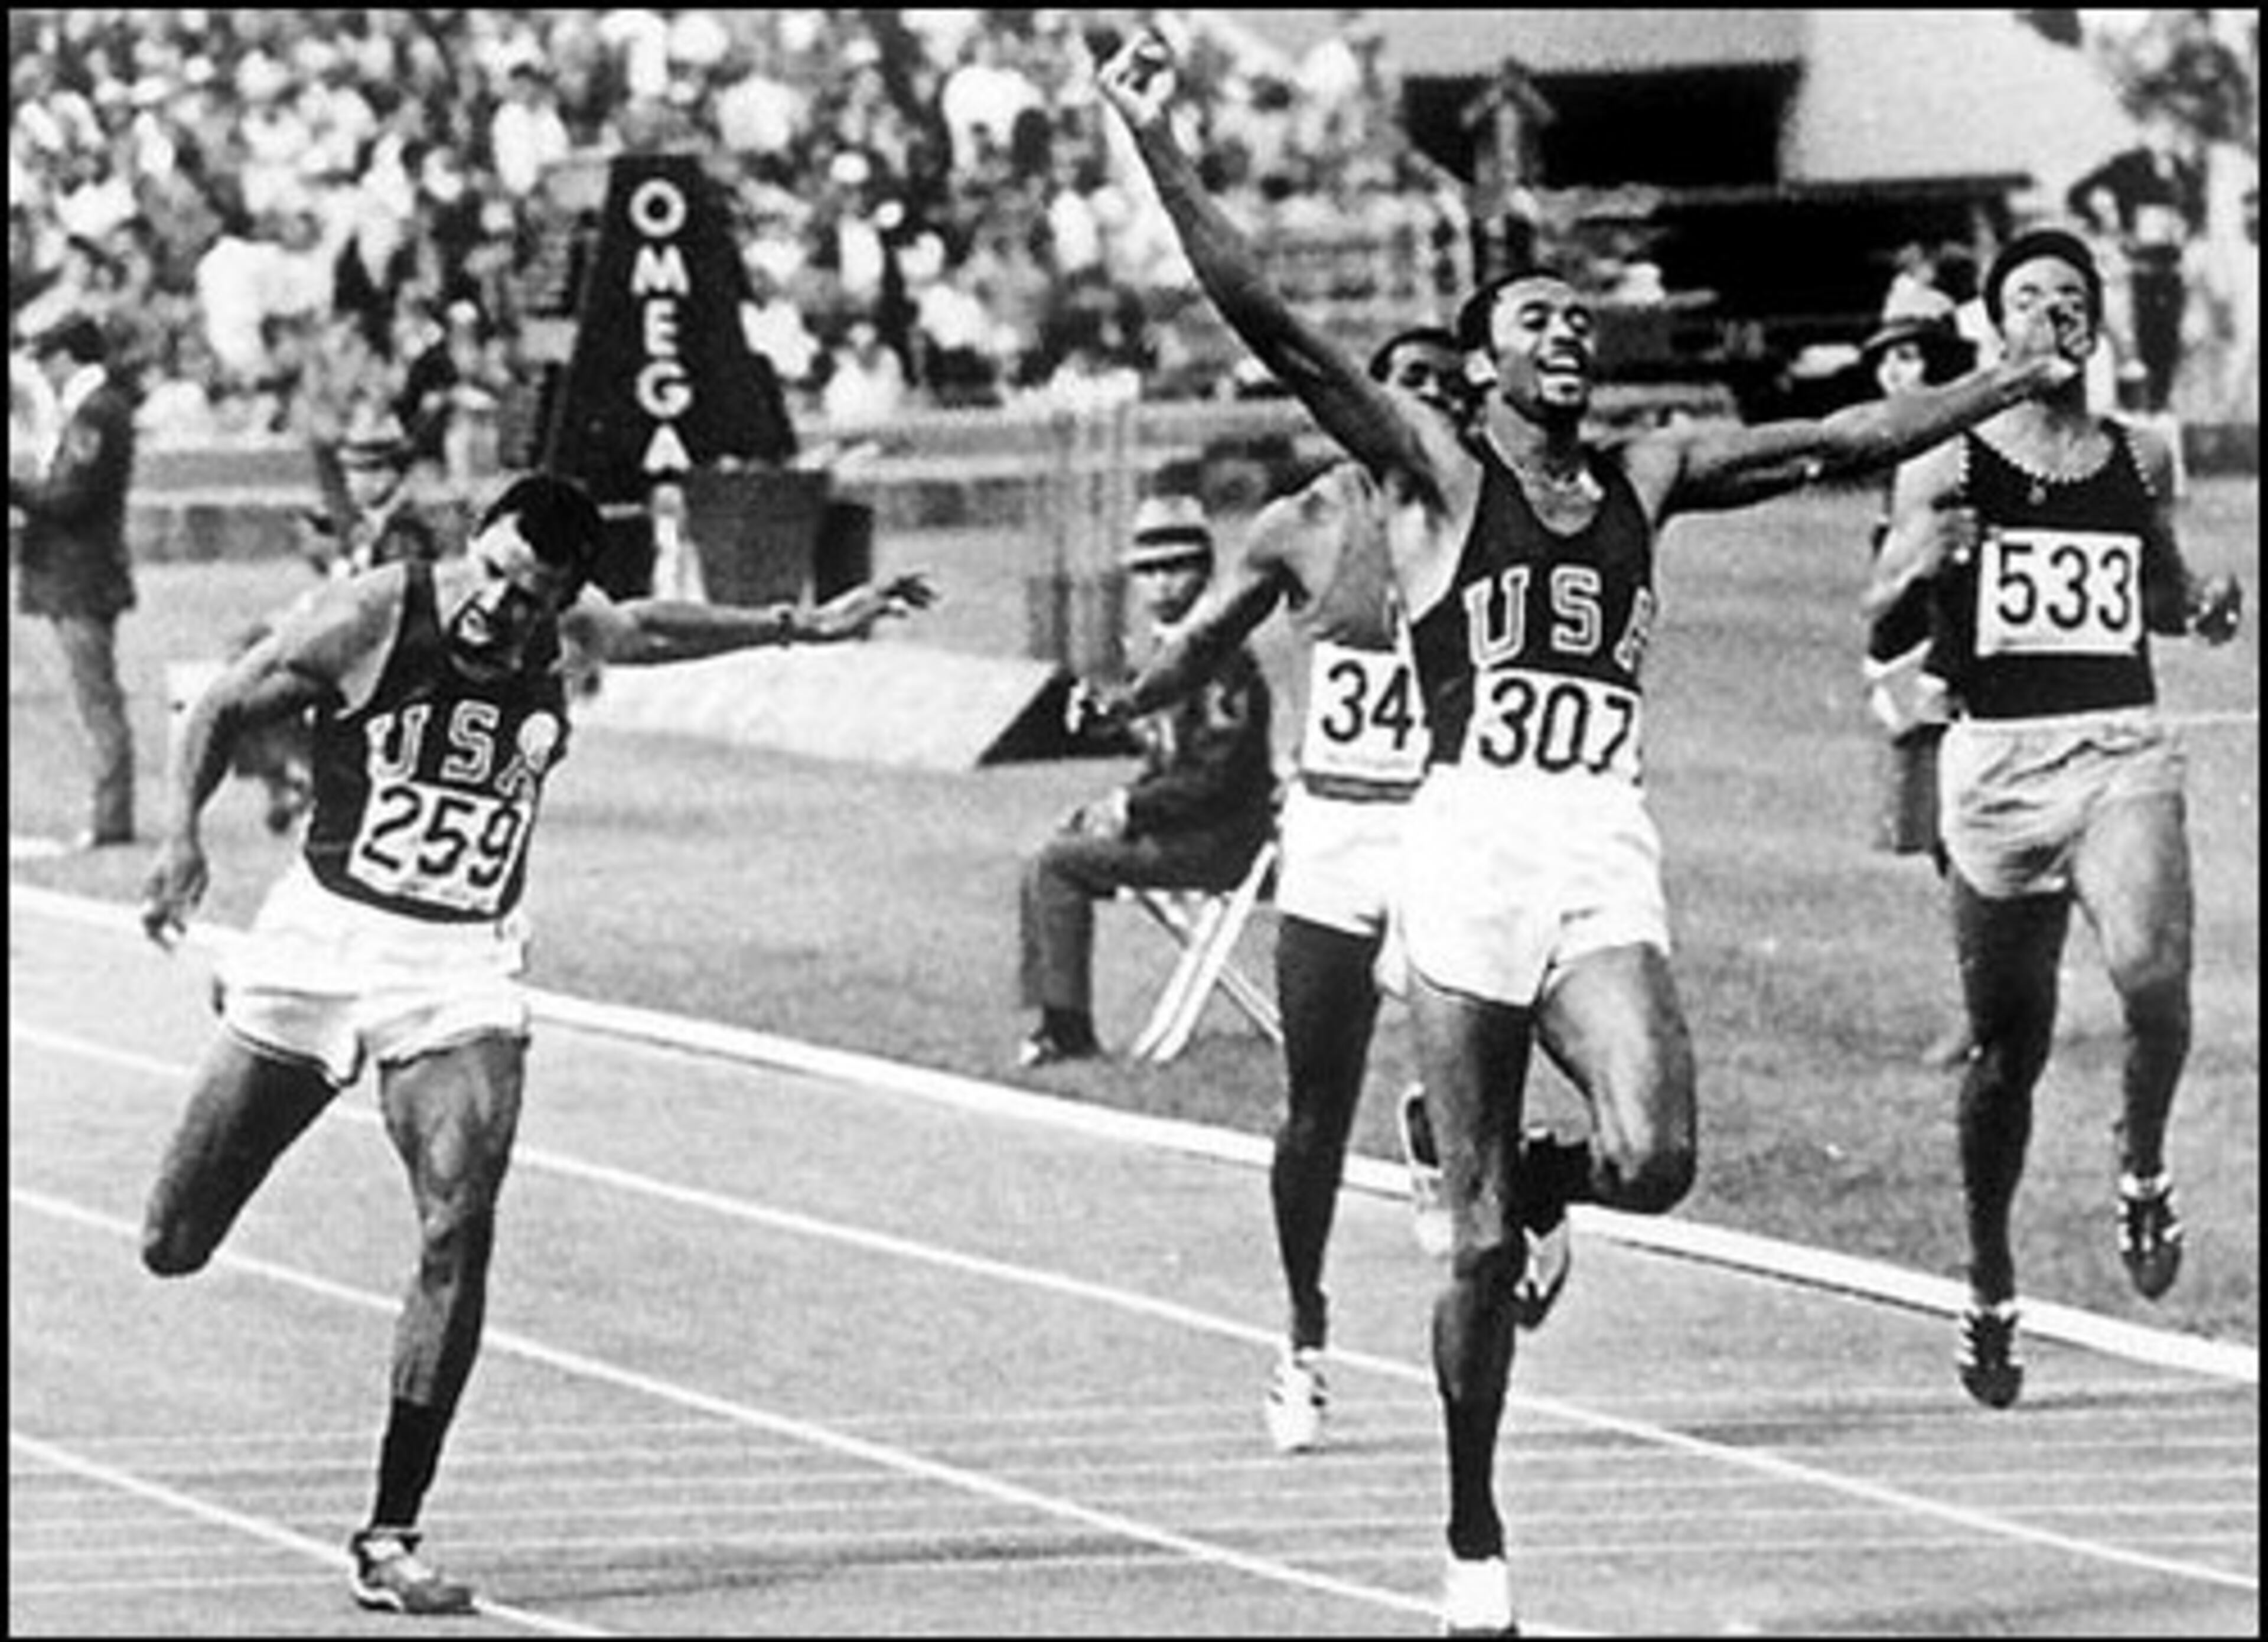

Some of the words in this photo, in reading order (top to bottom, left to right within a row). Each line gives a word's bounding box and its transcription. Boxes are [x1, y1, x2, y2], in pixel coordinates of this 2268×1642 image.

[630, 178, 693, 473] OMEGA
[1997, 544, 2132, 631] 533
[1479, 677, 1634, 774] 307
[361, 787, 523, 887] 259
